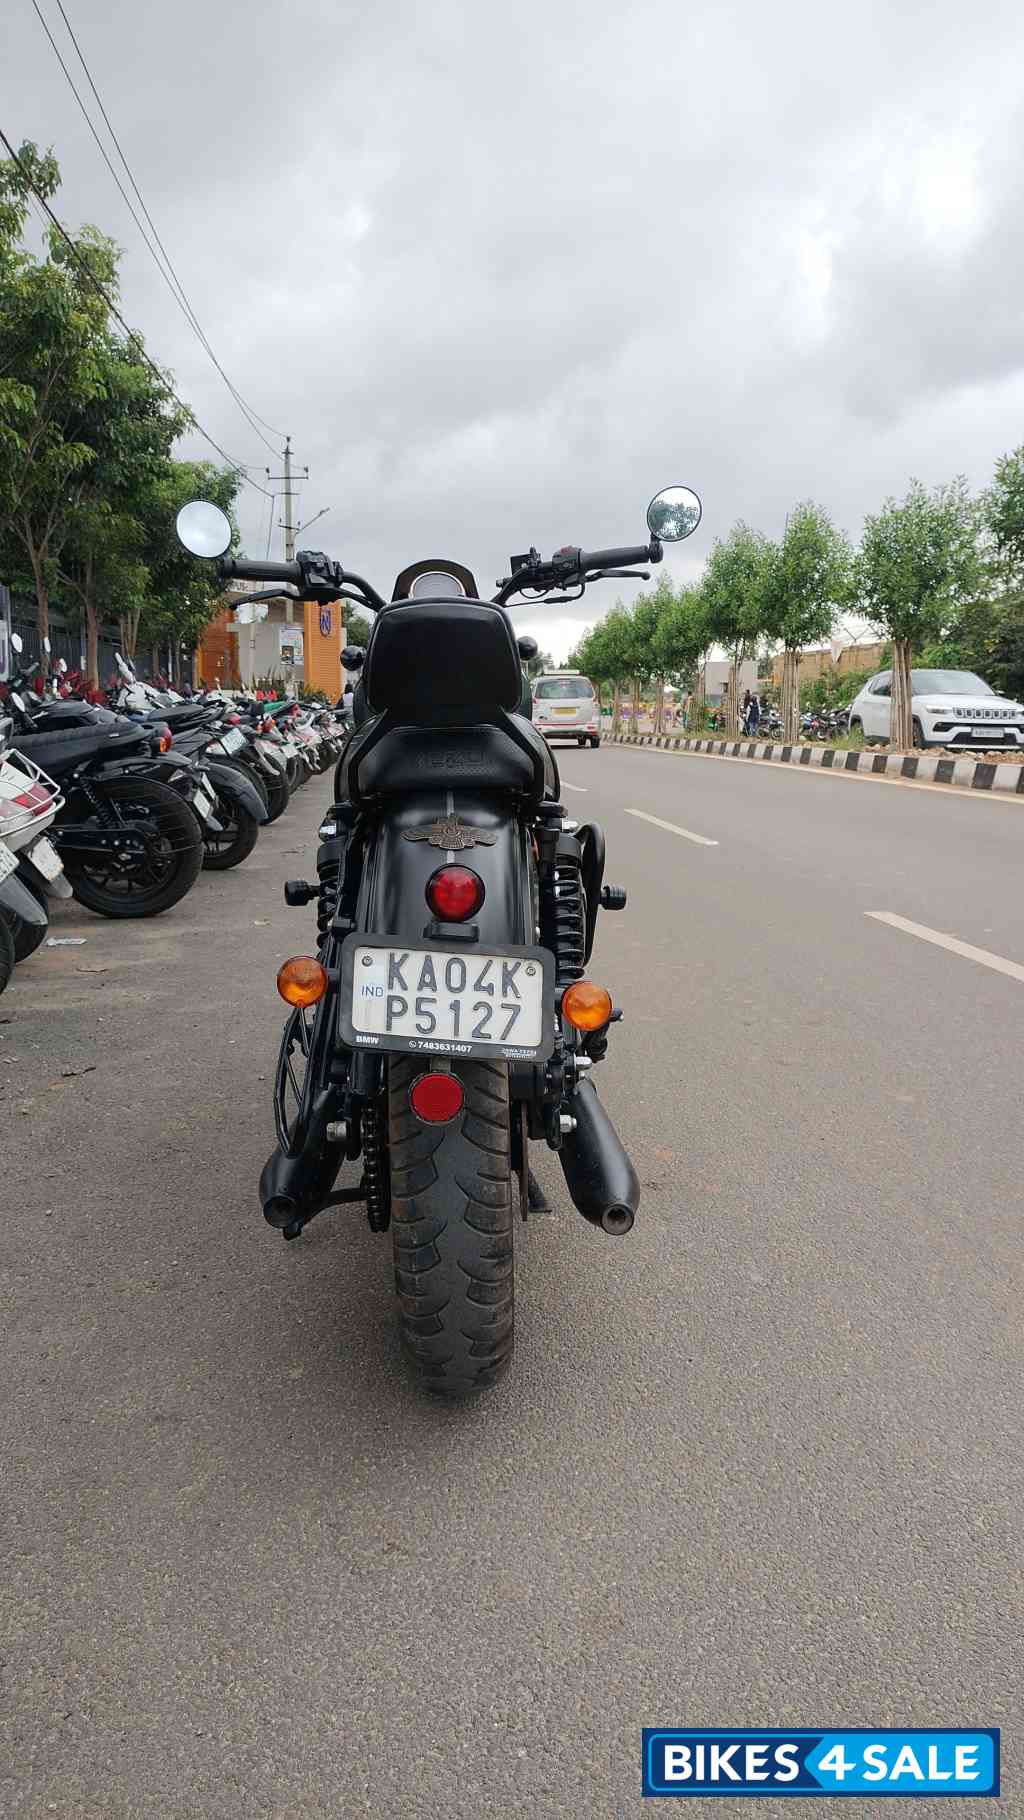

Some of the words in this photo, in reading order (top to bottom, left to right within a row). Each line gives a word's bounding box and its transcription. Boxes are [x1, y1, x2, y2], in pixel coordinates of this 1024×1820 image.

[388, 952, 521, 998] KA04K
[361, 985, 384, 998] IND
[386, 995, 521, 1040] P5127
[355, 1035, 380, 1045] BMW
